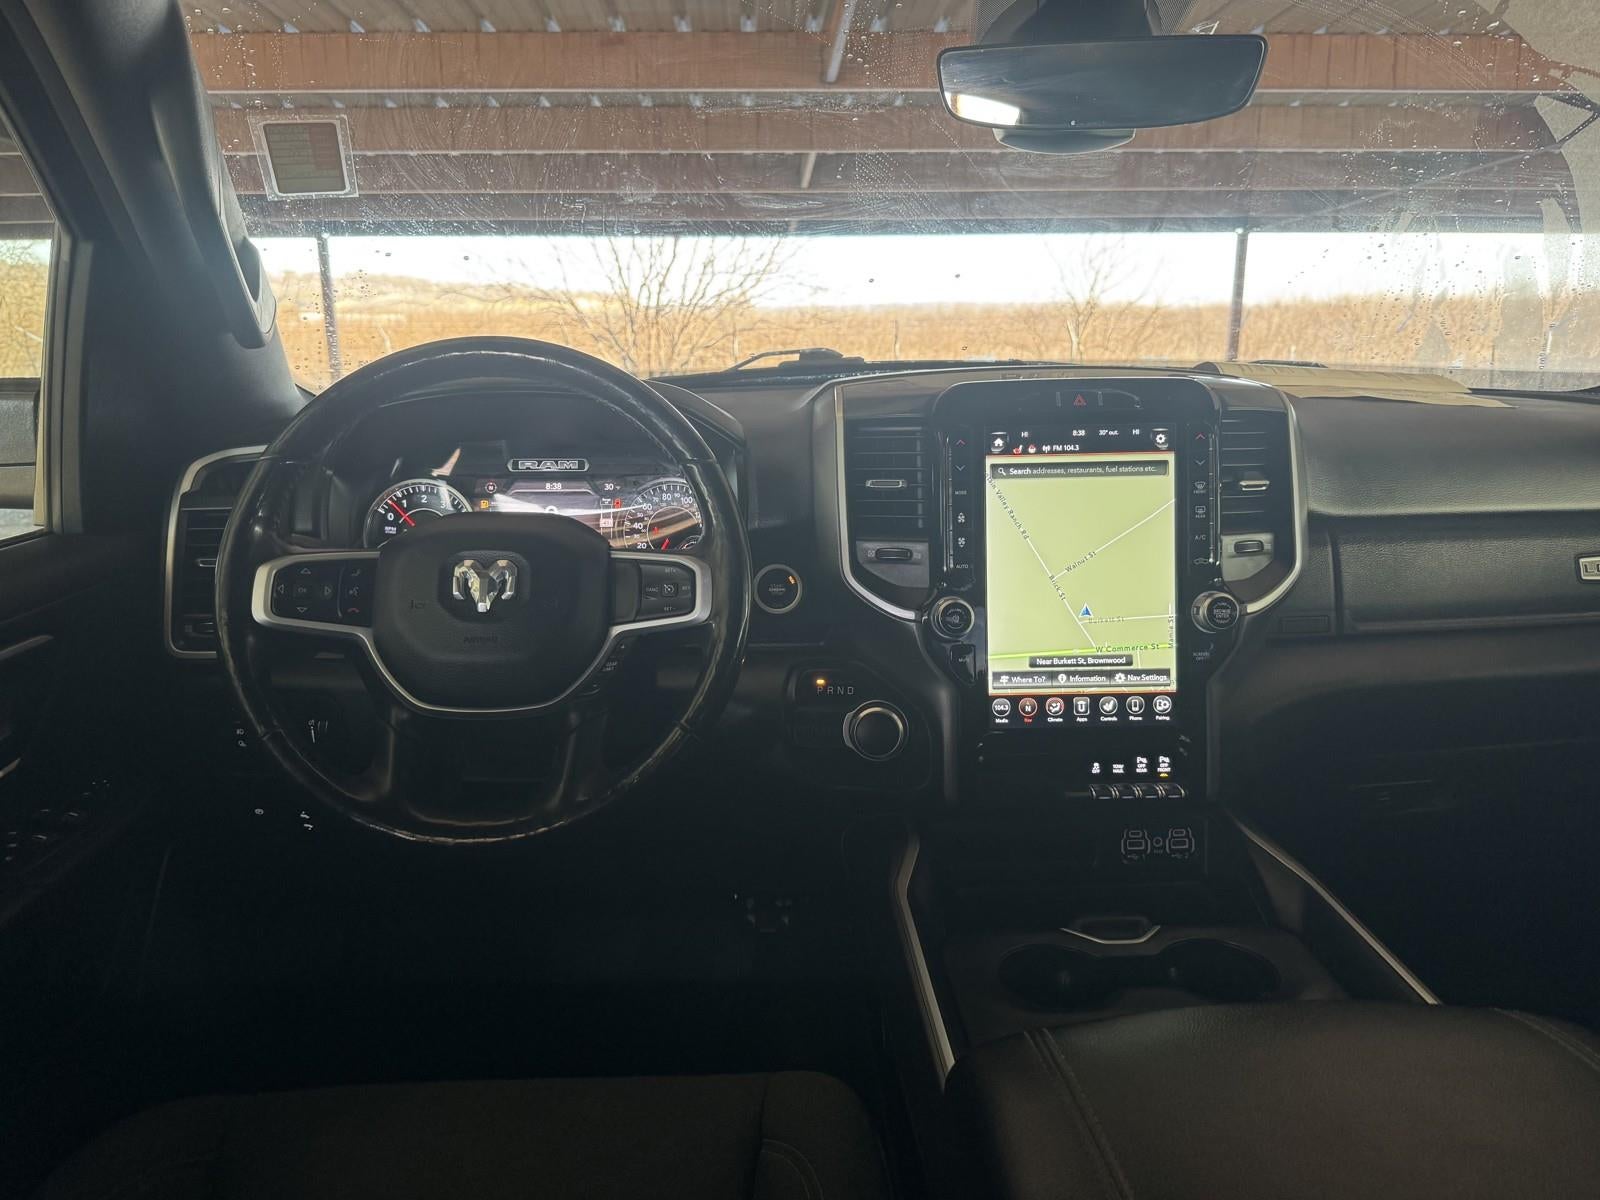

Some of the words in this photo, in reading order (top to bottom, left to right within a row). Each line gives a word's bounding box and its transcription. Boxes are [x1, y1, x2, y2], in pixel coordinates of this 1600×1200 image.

[1072, 429, 1086, 437] 8:38
[518, 460, 579, 469] RAM
[1009, 467, 1032, 475] Search
[1032, 467, 1066, 475] addresses,
[1067, 466, 1104, 474] restaurants,
[1105, 465, 1118, 473] fuel
[545, 482, 562, 490] 8:38
[604, 483, 614, 491] 30
[421, 495, 428, 503] 2
[662, 493, 672, 501] 80
[680, 496, 693, 505] 100
[402, 500, 408, 508] 1
[642, 503, 652, 511] 60
[387, 512, 394, 521] 0
[633, 522, 644, 530] 40
[1008, 509, 1022, 530] Ranch
[1020, 529, 1030, 541] Rd
[1065, 556, 1089, 572] Walnut
[1088, 551, 1097, 559] St
[1049, 574, 1061, 592] Brick
[1058, 591, 1067, 601] St
[1115, 615, 1125, 623] St
[1167, 615, 1174, 624] St
[1105, 644, 1149, 653] Commerce
[1053, 657, 1076, 665] Burkett
[1087, 656, 1126, 665] Brownwood
[1011, 675, 1032, 683] Where
[1033, 675, 1046, 683] To?
[1069, 674, 1106, 682] Information
[1141, 673, 1167, 682] Settings
[827, 686, 833, 694] R
[837, 686, 845, 695] N
